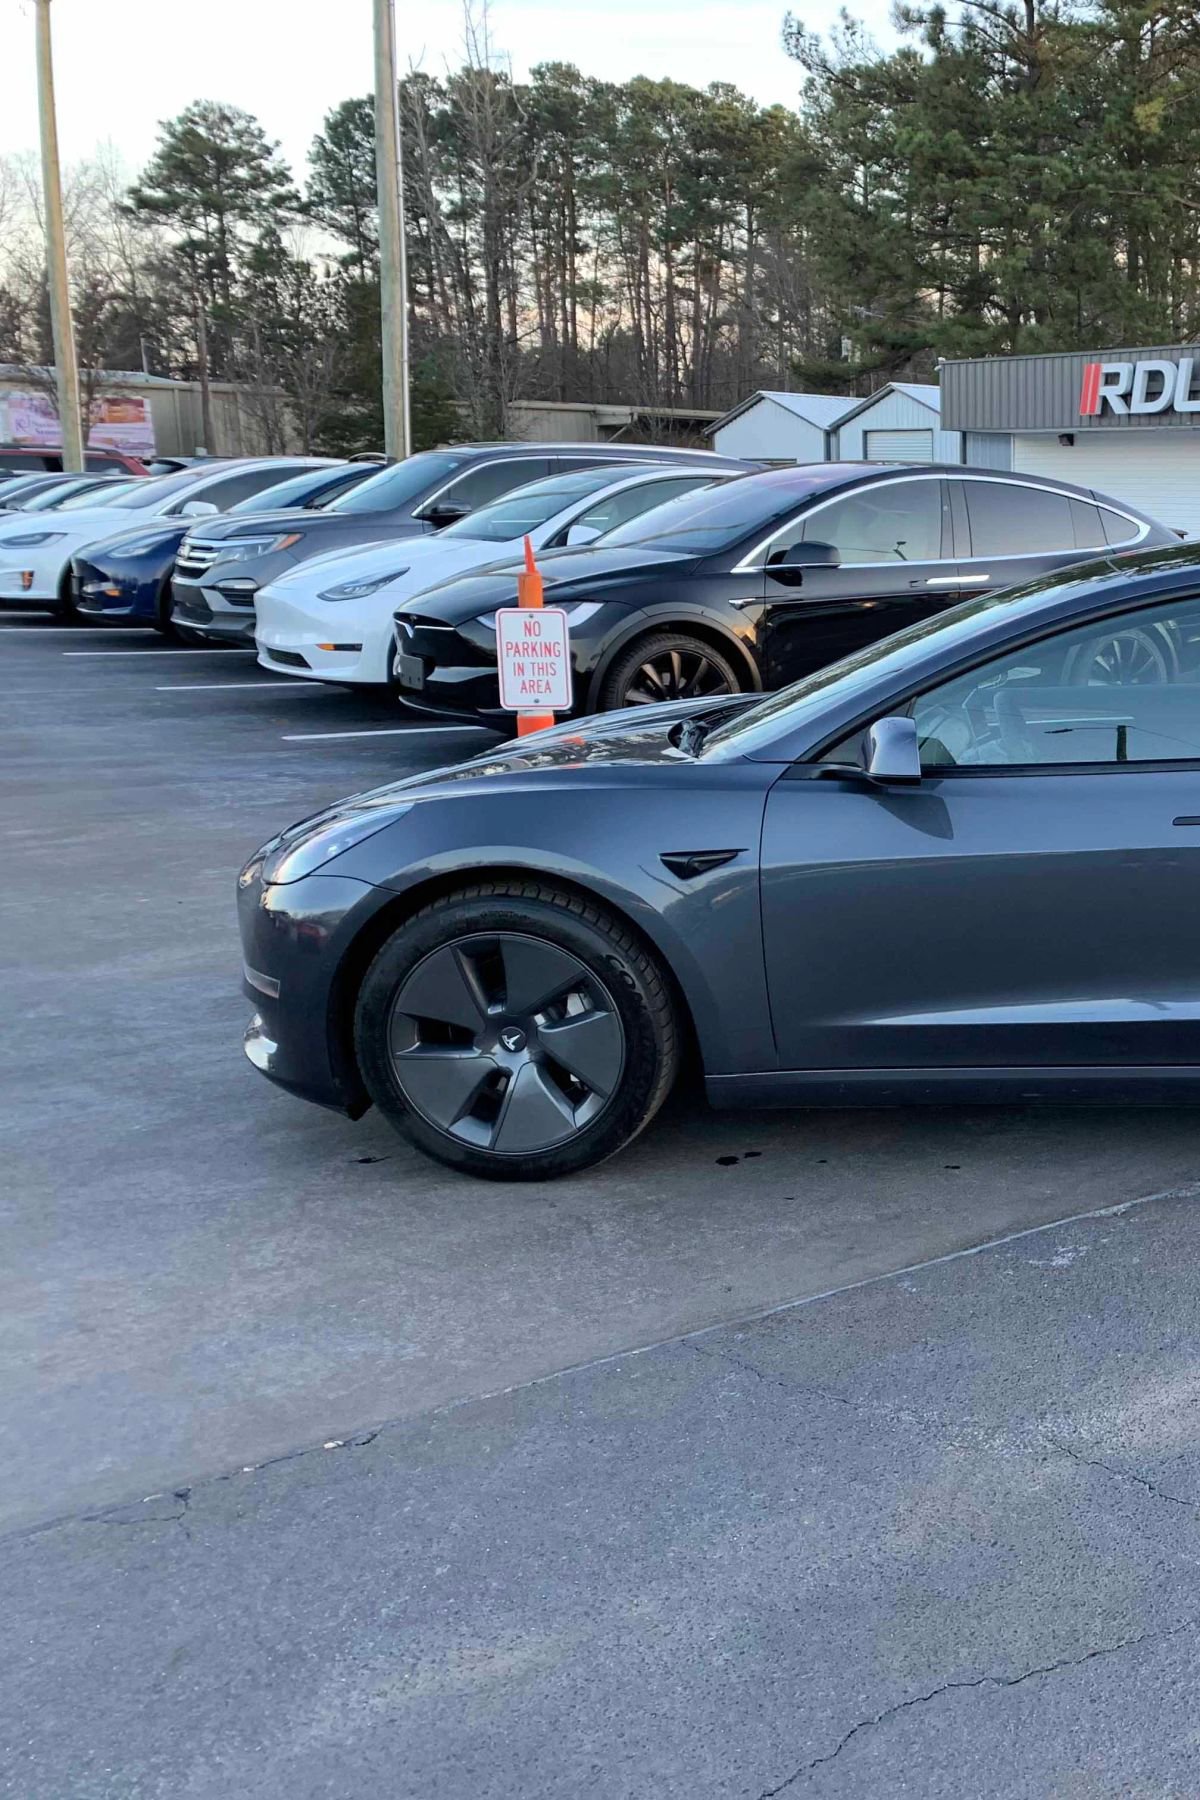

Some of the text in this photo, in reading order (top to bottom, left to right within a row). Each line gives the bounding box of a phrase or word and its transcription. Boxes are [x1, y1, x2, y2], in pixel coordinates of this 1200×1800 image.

[524, 621, 541, 637] NO
[505, 641, 561, 657] PARKING
[513, 662, 557, 676] IN THIS
[520, 680, 552, 694] AREA
